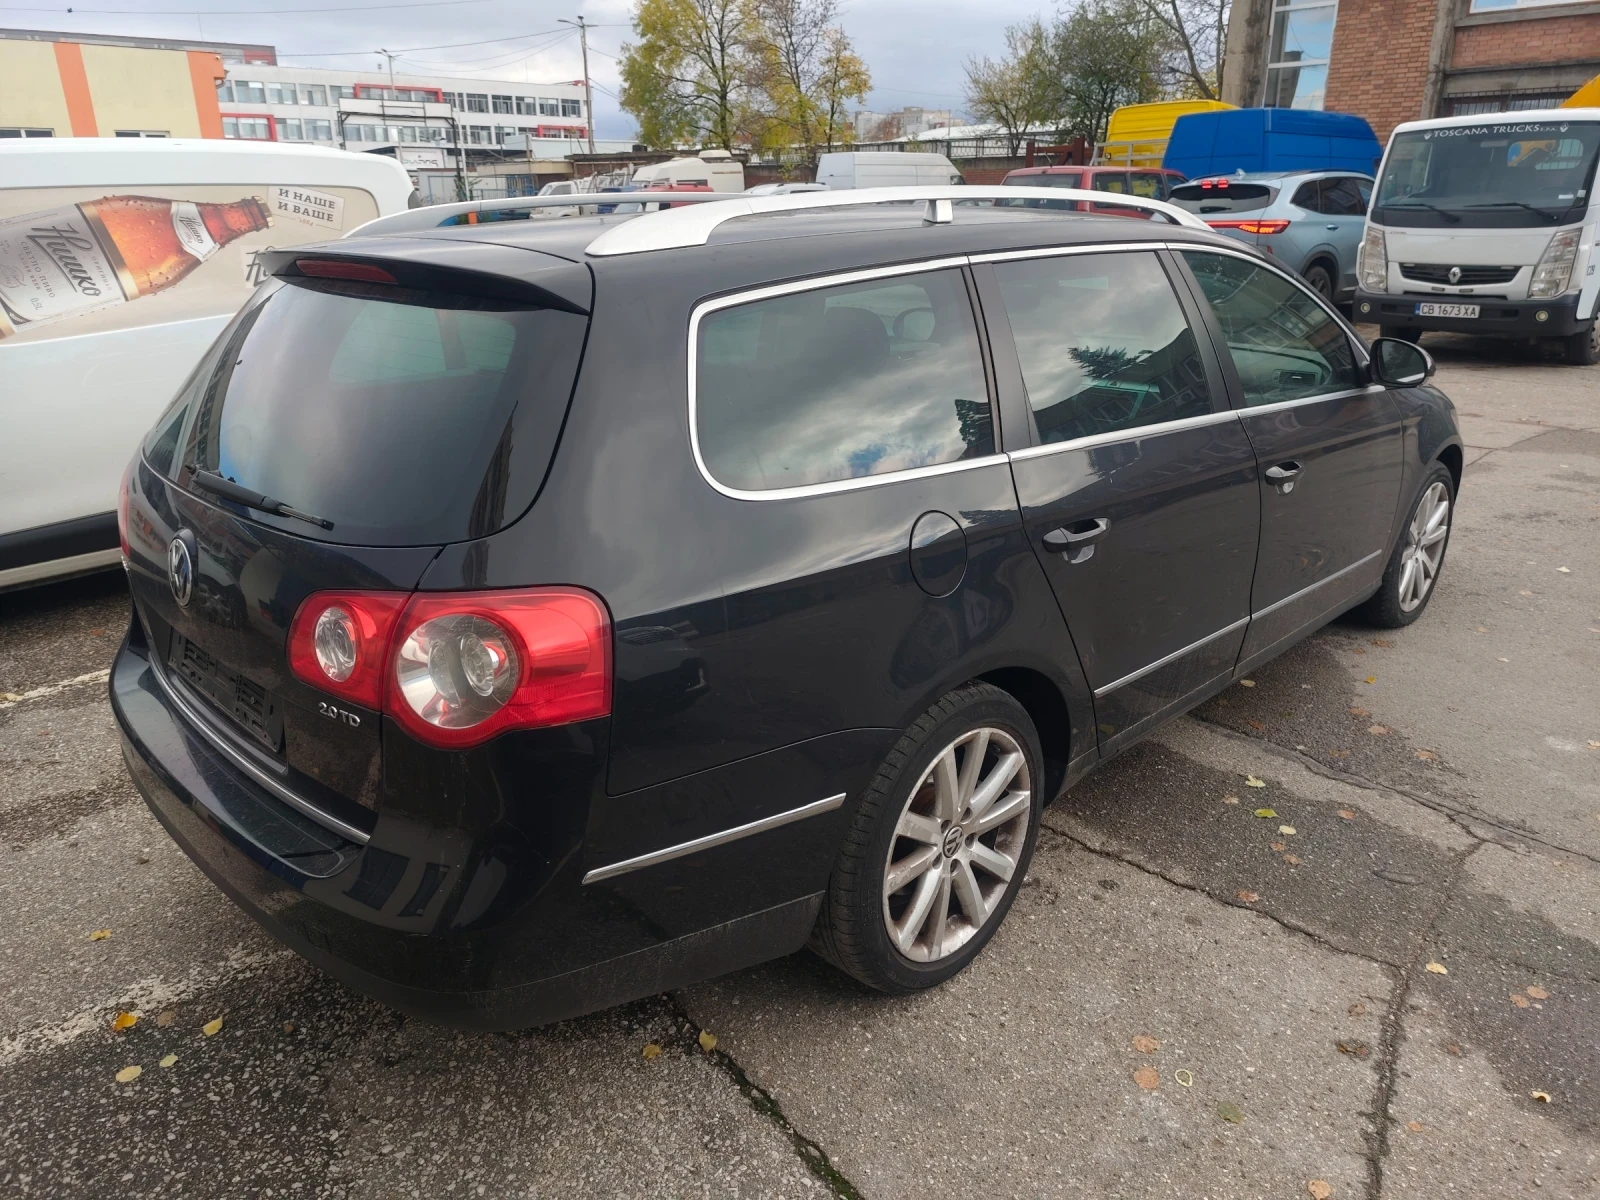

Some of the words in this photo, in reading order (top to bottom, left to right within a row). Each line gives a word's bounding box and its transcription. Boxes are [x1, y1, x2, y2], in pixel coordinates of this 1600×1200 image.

[1433, 127, 1488, 138] TOSCANA
[1492, 124, 1540, 134] TRUCKS
[278, 188, 289, 198] И
[293, 191, 336, 210] НАШЕ
[277, 201, 288, 211] И
[292, 205, 334, 222] ВАШЕ
[20, 241, 42, 273] СВЕТЛО
[39, 275, 56, 298] ПИВО
[1421, 304, 1434, 315] CB
[1438, 305, 1461, 316] 1673
[1463, 306, 1476, 317] XA
